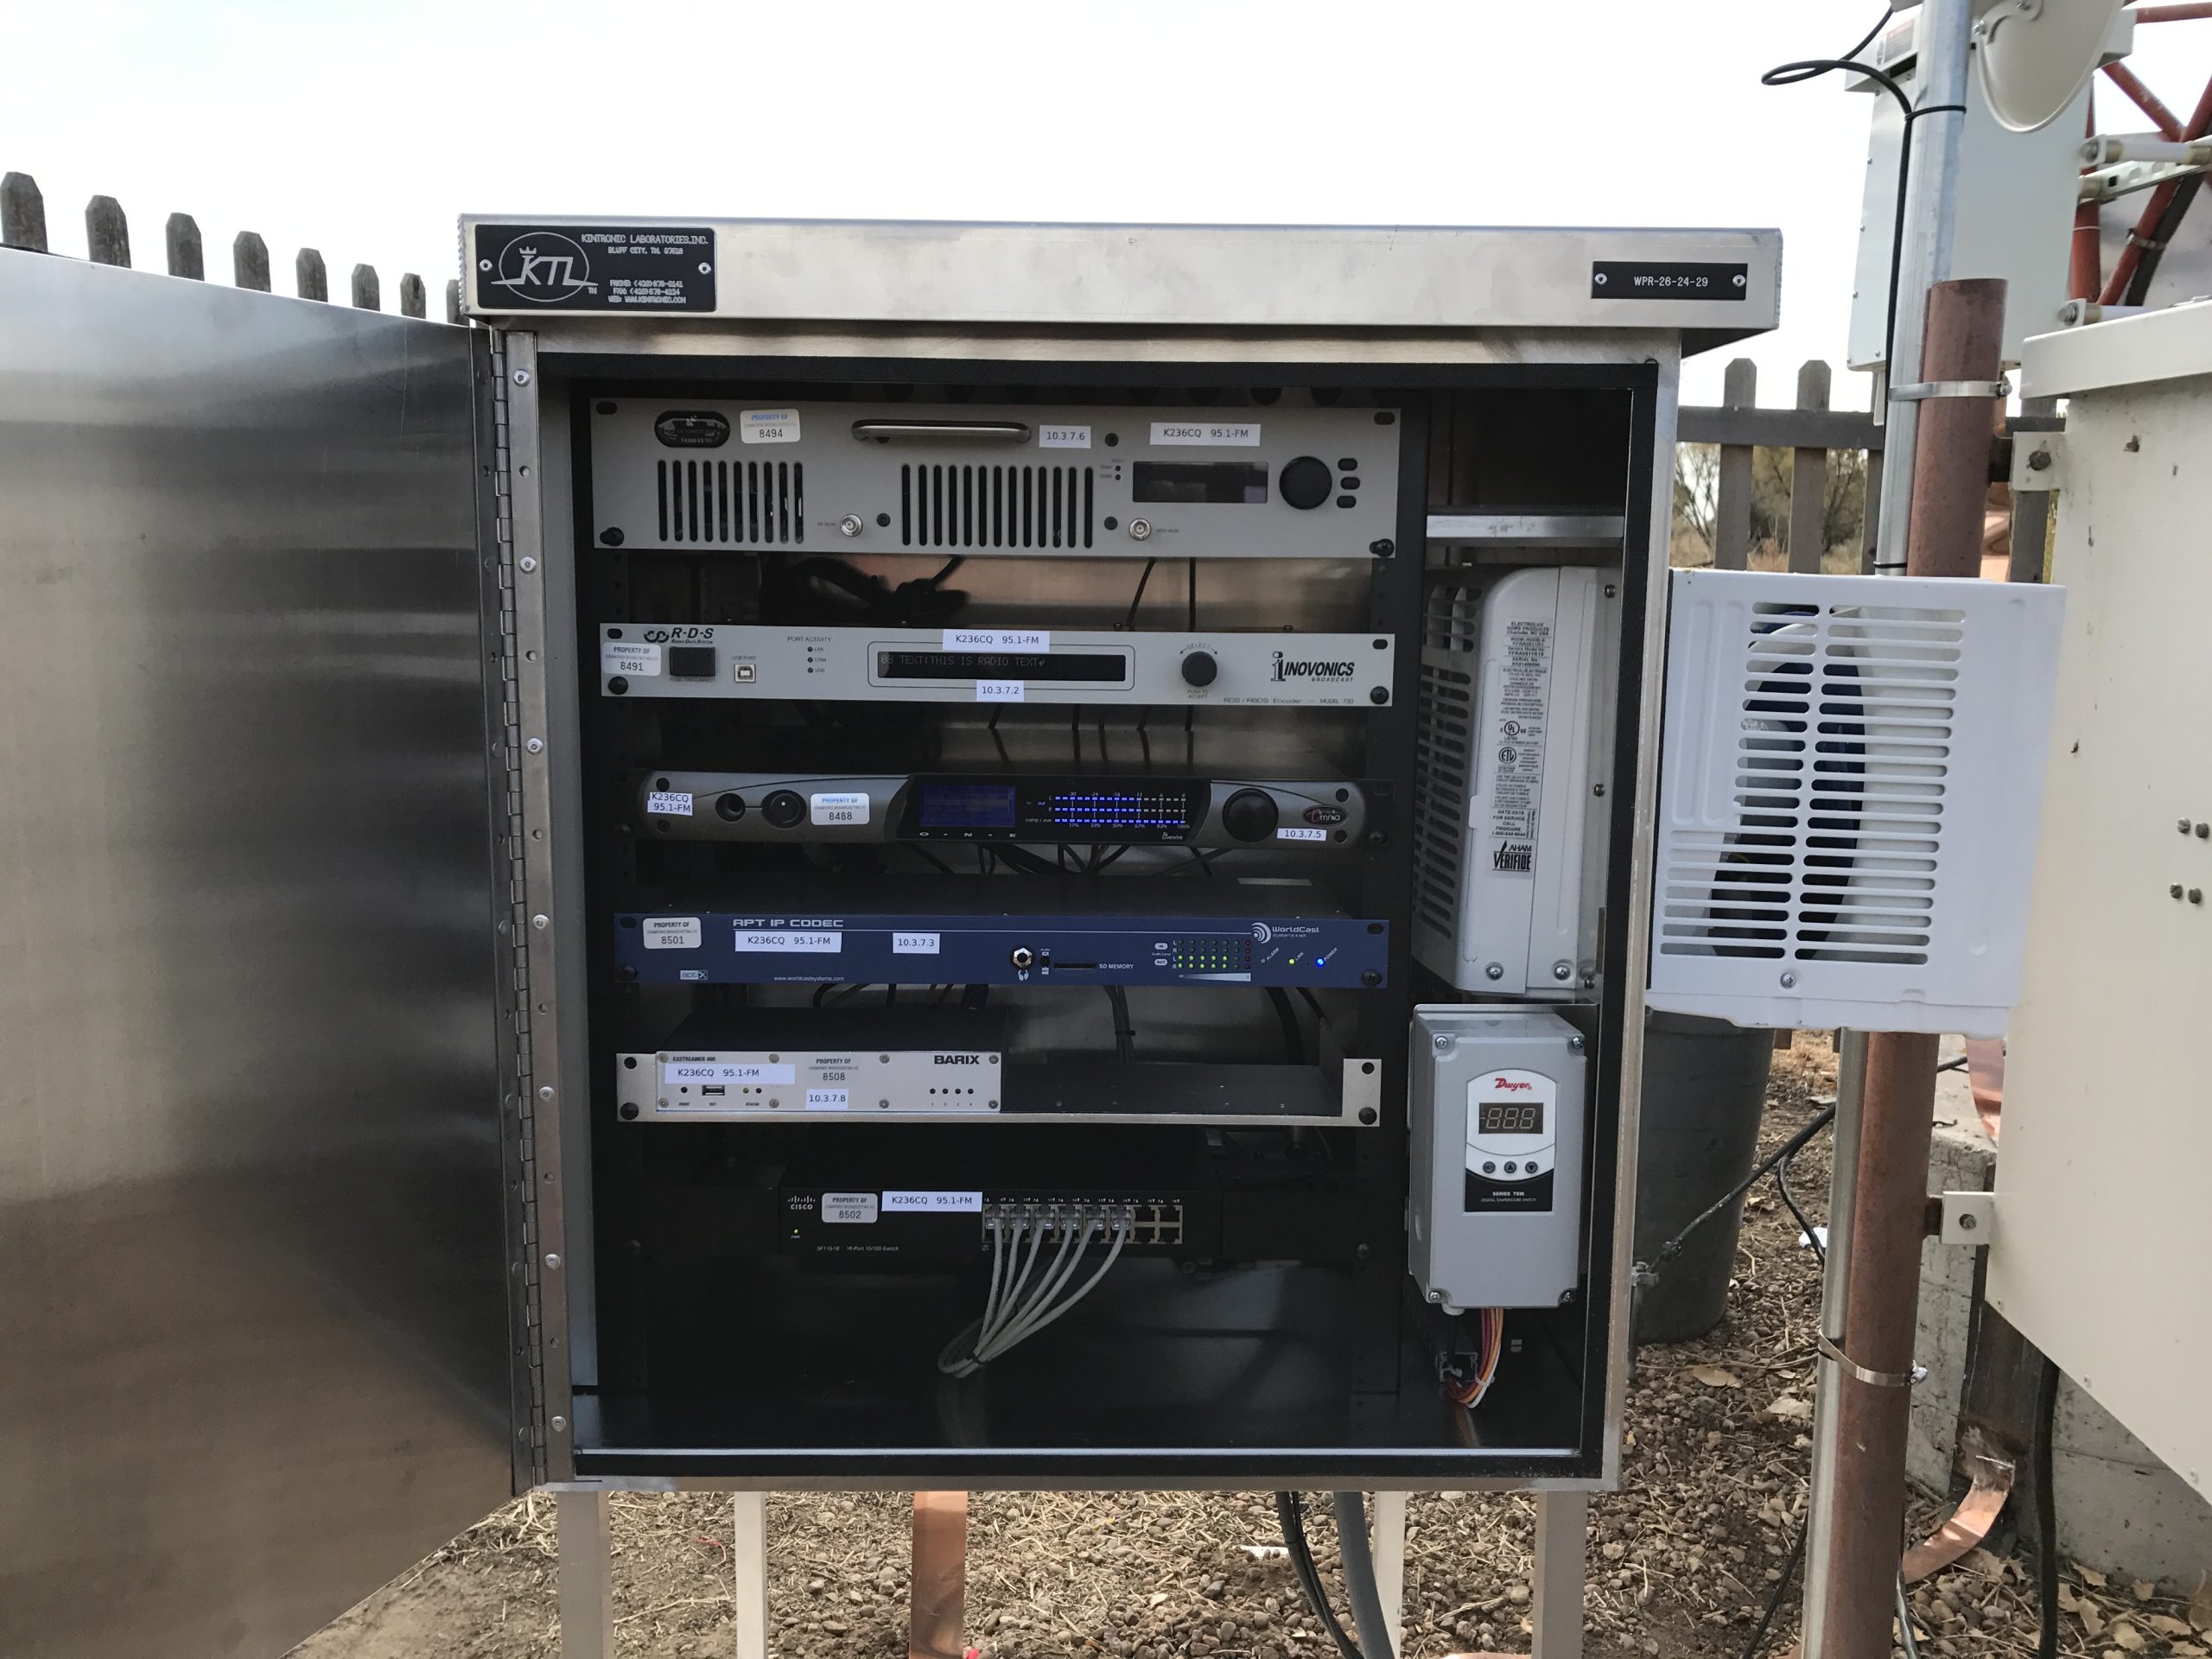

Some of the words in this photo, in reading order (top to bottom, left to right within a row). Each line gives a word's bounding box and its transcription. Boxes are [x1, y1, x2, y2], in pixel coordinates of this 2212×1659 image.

[582, 234, 626, 243] KINTRONIC
[506, 255, 588, 286] KTL
[1634, 276, 1708, 287] WPR-26-24-29
[759, 429, 783, 438] 8494
[1046, 431, 1085, 442] 10.3.7.6
[1163, 429, 1202, 439] K236CQ
[1210, 429, 1249, 438] 95.1-FM
[956, 634, 994, 645] K236CQ
[1001, 635, 1039, 645] 95.1-FM
[620, 661, 644, 671] 8491
[961, 656, 972, 665] IS
[977, 657, 1009, 666] RADIO
[1283, 661, 1355, 677] INOVONICS
[982, 686, 1020, 695] 10.3.7.2
[652, 791, 689, 803] K236CQ
[653, 803, 690, 812] 95.1-FM
[829, 811, 853, 821] 8488
[1312, 809, 1340, 823] Omnia
[1284, 830, 1322, 838] 10.3.7.5
[1508, 843, 1532, 853] AHAM
[733, 918, 766, 928] APT
[770, 919, 785, 928] IP
[790, 919, 844, 928] CODEC
[661, 935, 684, 945] 8501
[747, 936, 785, 946] K236CQ
[793, 937, 831, 946] 95.1-FM
[898, 938, 935, 947] 10.3.7.3
[1265, 947, 1280, 962] ALARM
[934, 1055, 980, 1065] BARIX
[677, 1069, 715, 1077] K236CQ
[722, 1069, 760, 1077] 95.1-FM
[823, 1072, 846, 1081] 8508
[1495, 1077, 1530, 1092] Dwyer
[809, 1094, 846, 1103] 10.3.7.8
[892, 1196, 928, 1205] K236CQ
[936, 1196, 973, 1205] 95.1-FM
[838, 1211, 861, 1219] 8502
